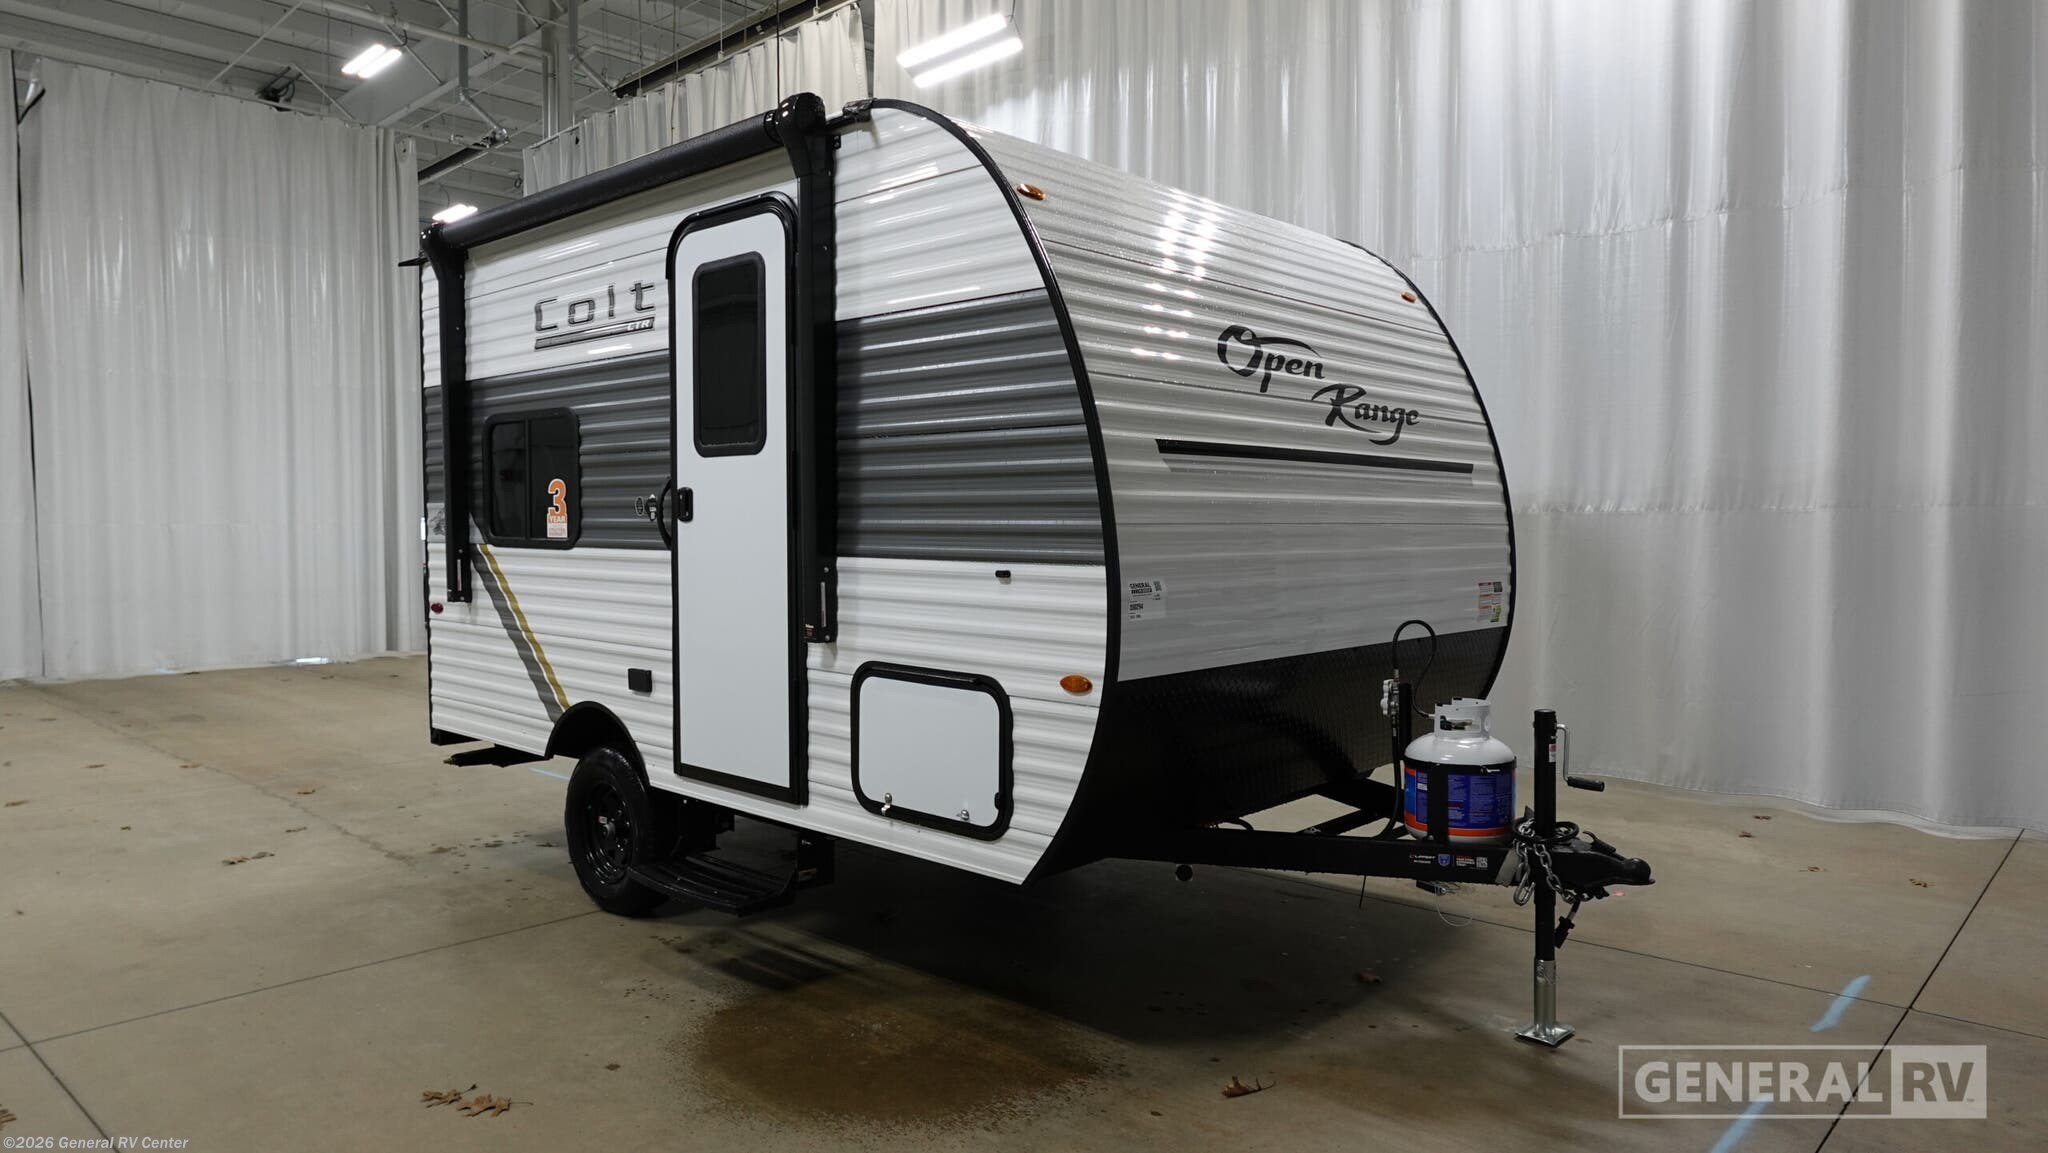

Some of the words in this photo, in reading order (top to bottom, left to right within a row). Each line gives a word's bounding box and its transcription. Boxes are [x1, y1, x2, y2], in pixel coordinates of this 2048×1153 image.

[534, 281, 655, 332] Colt
[627, 319, 650, 331] CTR
[1217, 325, 1325, 393] Open
[1311, 383, 1420, 446] Range
[548, 478, 567, 516] 3
[549, 515, 566, 523] YEAR
